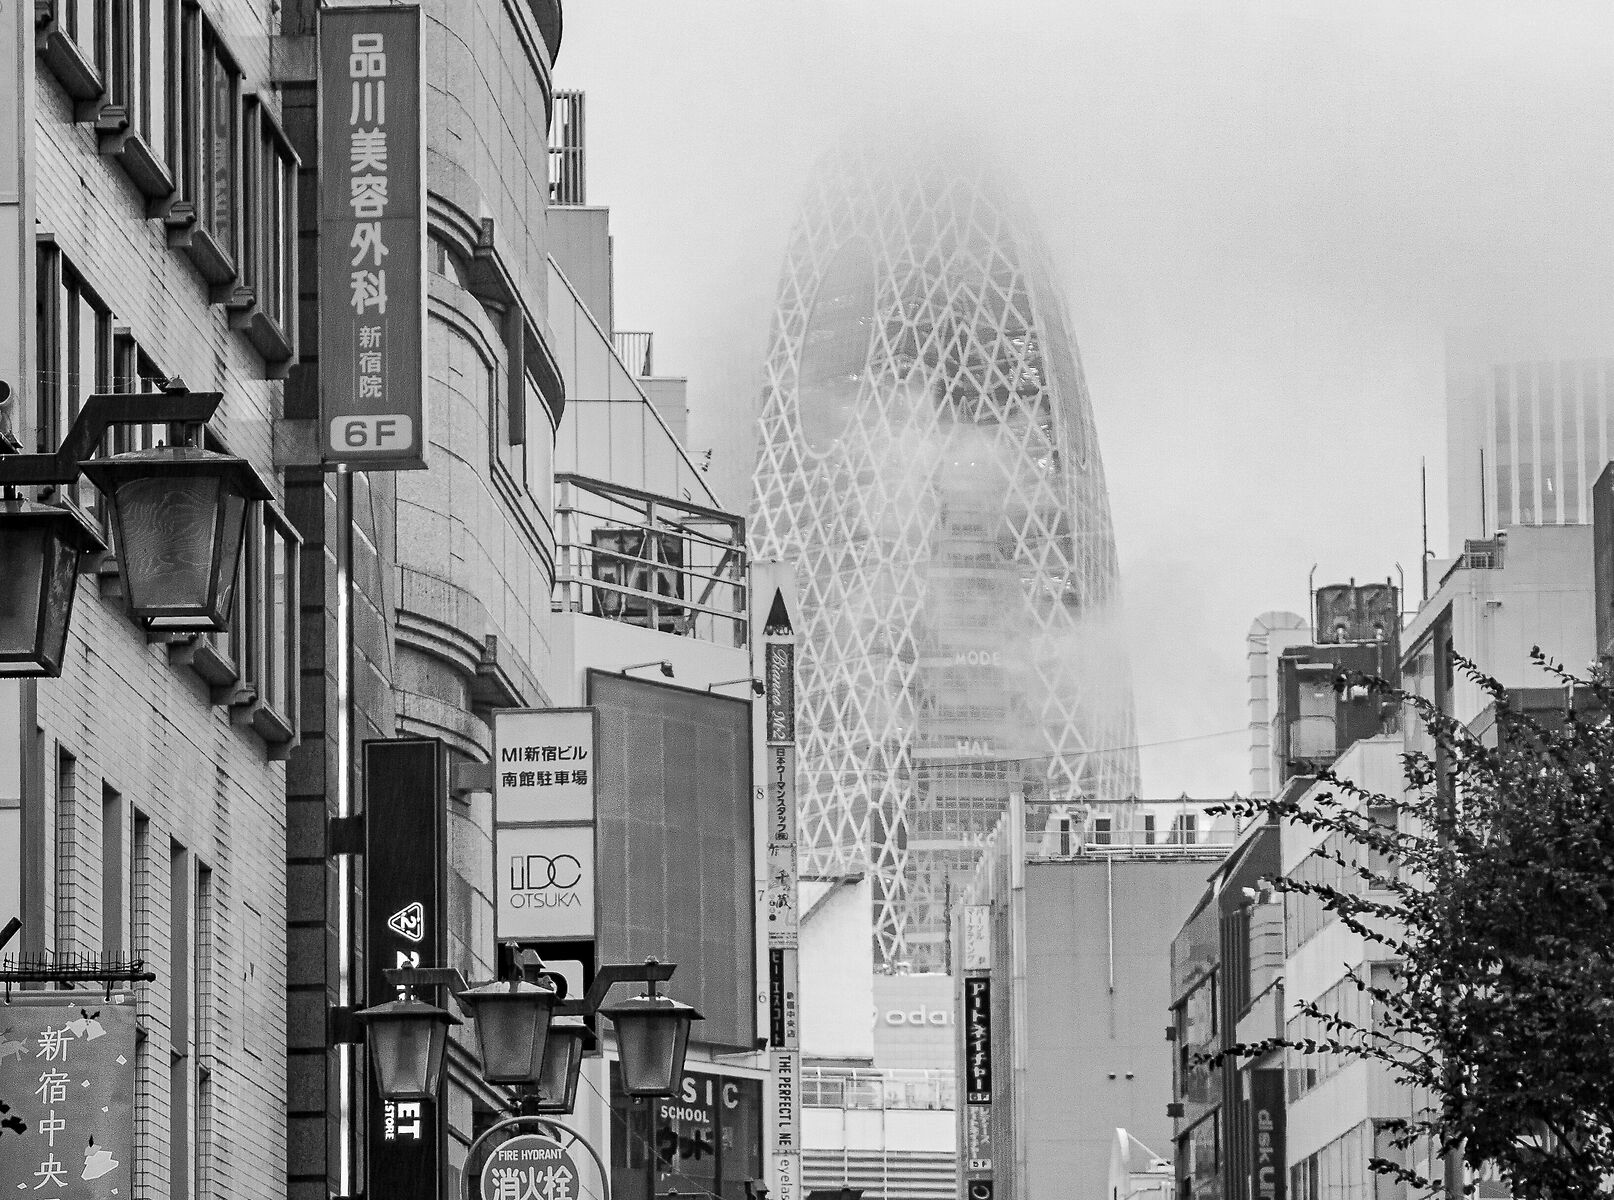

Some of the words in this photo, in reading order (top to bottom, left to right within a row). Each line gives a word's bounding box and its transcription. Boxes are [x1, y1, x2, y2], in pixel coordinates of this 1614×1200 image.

[350, 33, 389, 315] 品川美容外科
[358, 325, 382, 399] 新宿院
[344, 420, 397, 447] 6F
[502, 746, 588, 763] MI新宿ビル
[957, 741, 995, 756] HAL
[501, 770, 588, 787] 南館駐車場
[756, 788, 765, 800] 8
[511, 855, 581, 890] IDC
[510, 893, 581, 909] OTSUKA
[886, 1004, 954, 1024] oda
[779, 1055, 792, 1074] THE
[680, 1076, 740, 1109] SIC
[778, 1076, 792, 1120] PERFECT
[660, 1105, 710, 1123] SCHOOL
[499, 1150, 520, 1162] FIRE
[521, 1149, 564, 1161] HYDRANT
